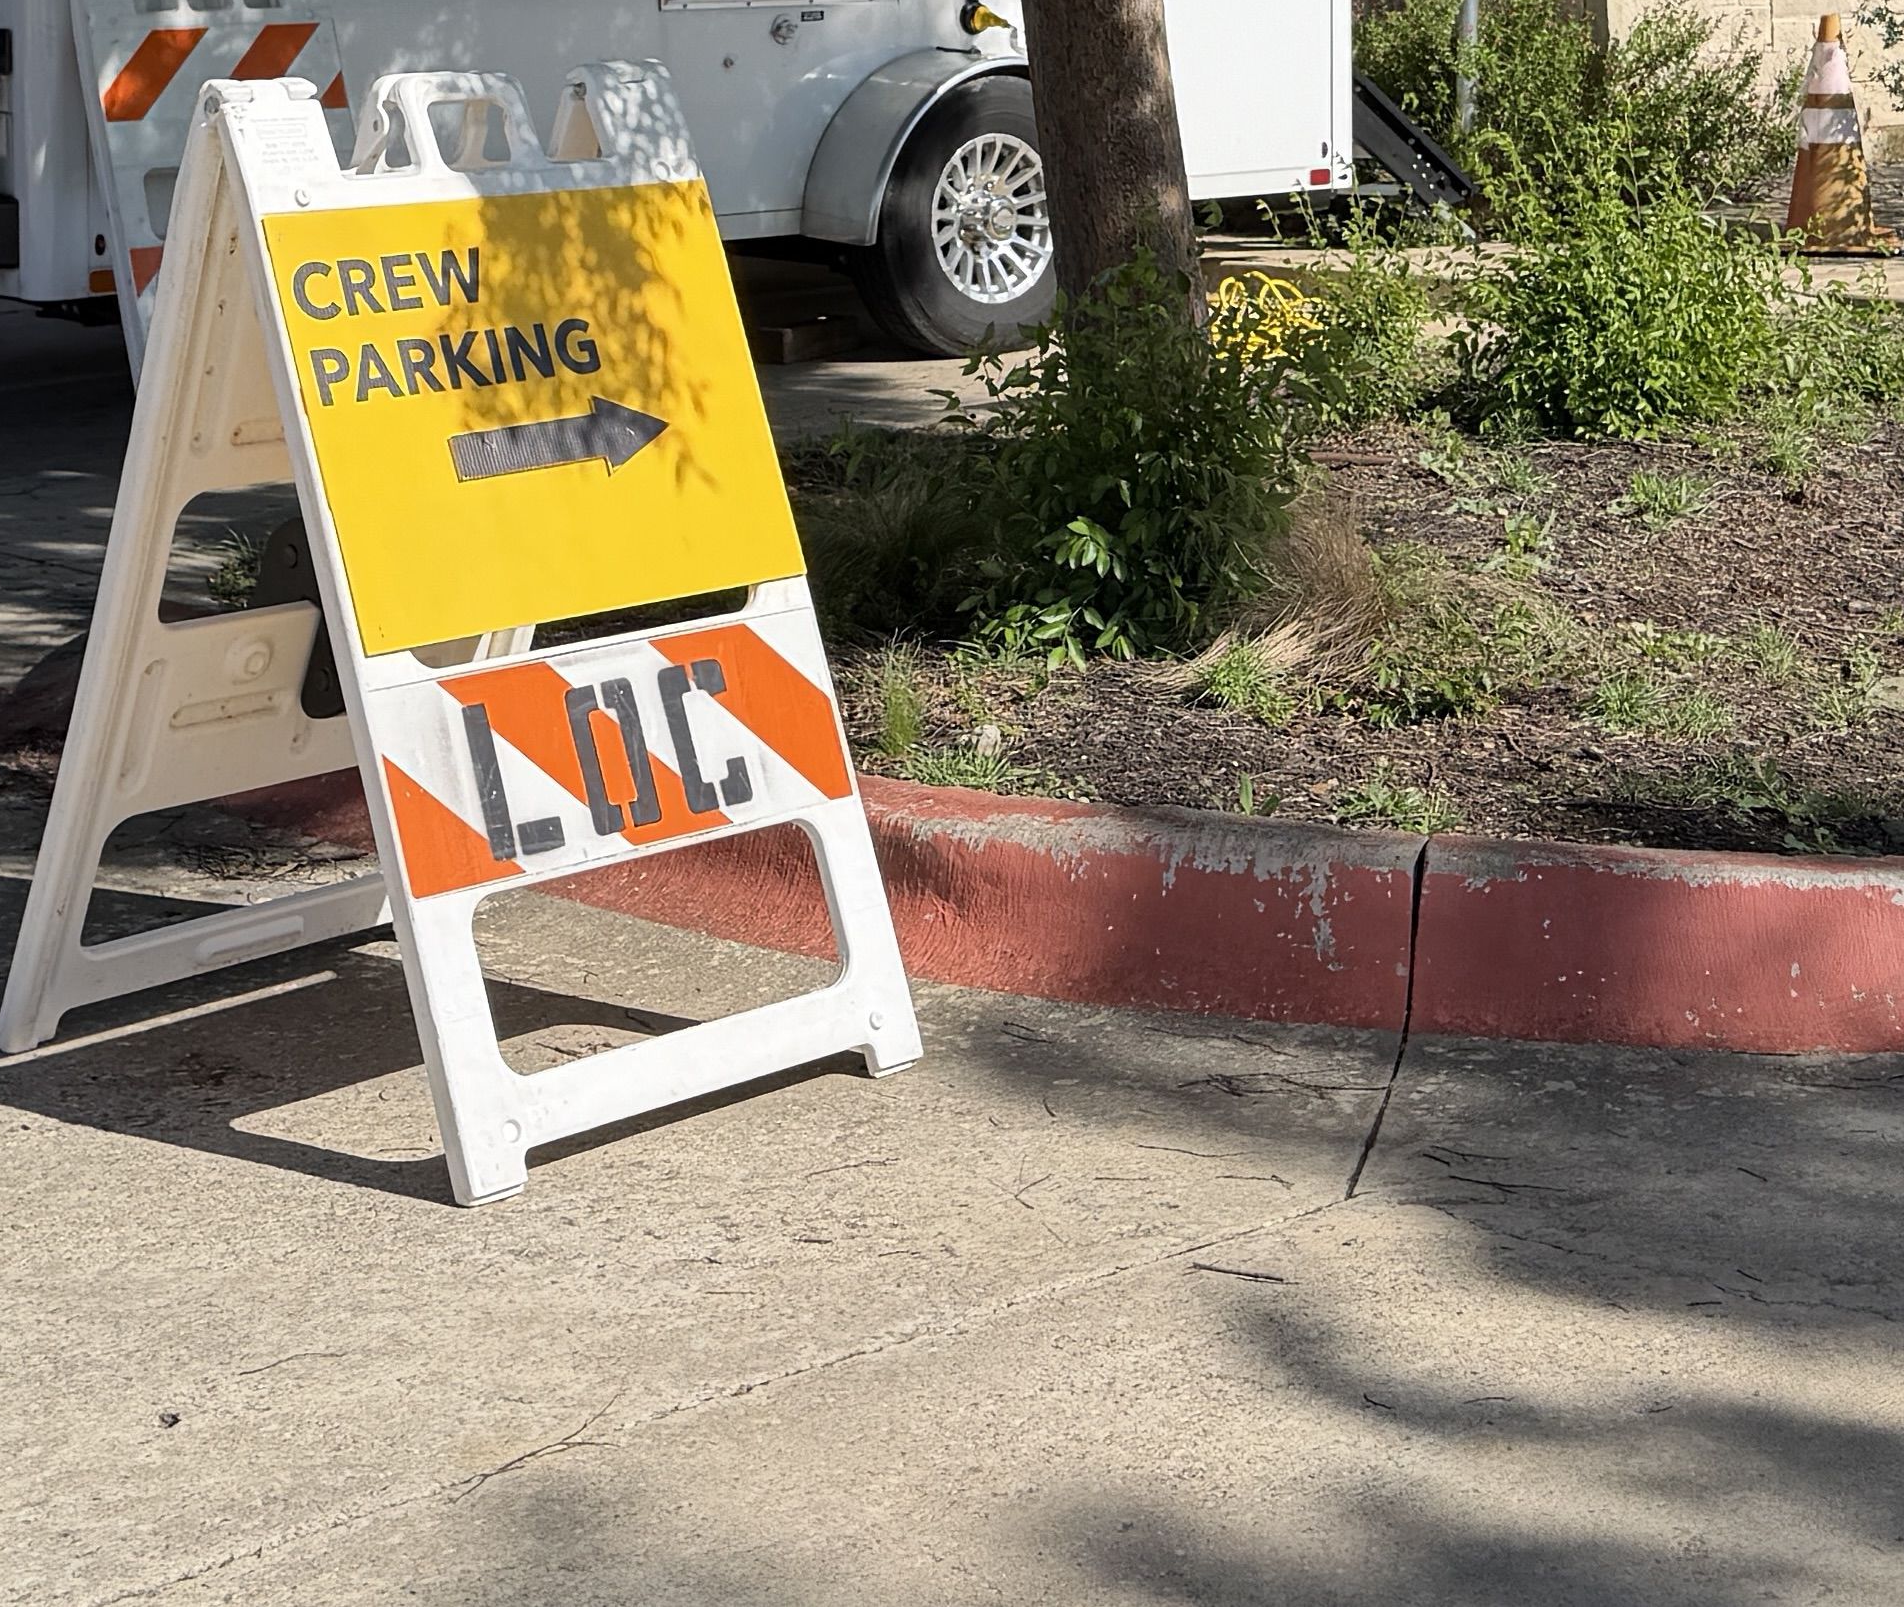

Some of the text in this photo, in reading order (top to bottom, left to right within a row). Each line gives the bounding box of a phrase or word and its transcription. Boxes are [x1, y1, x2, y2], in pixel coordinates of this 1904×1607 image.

[293, 247, 480, 320] CREW
[310, 318, 602, 407] PARKING
[462, 658, 753, 861] LOC
